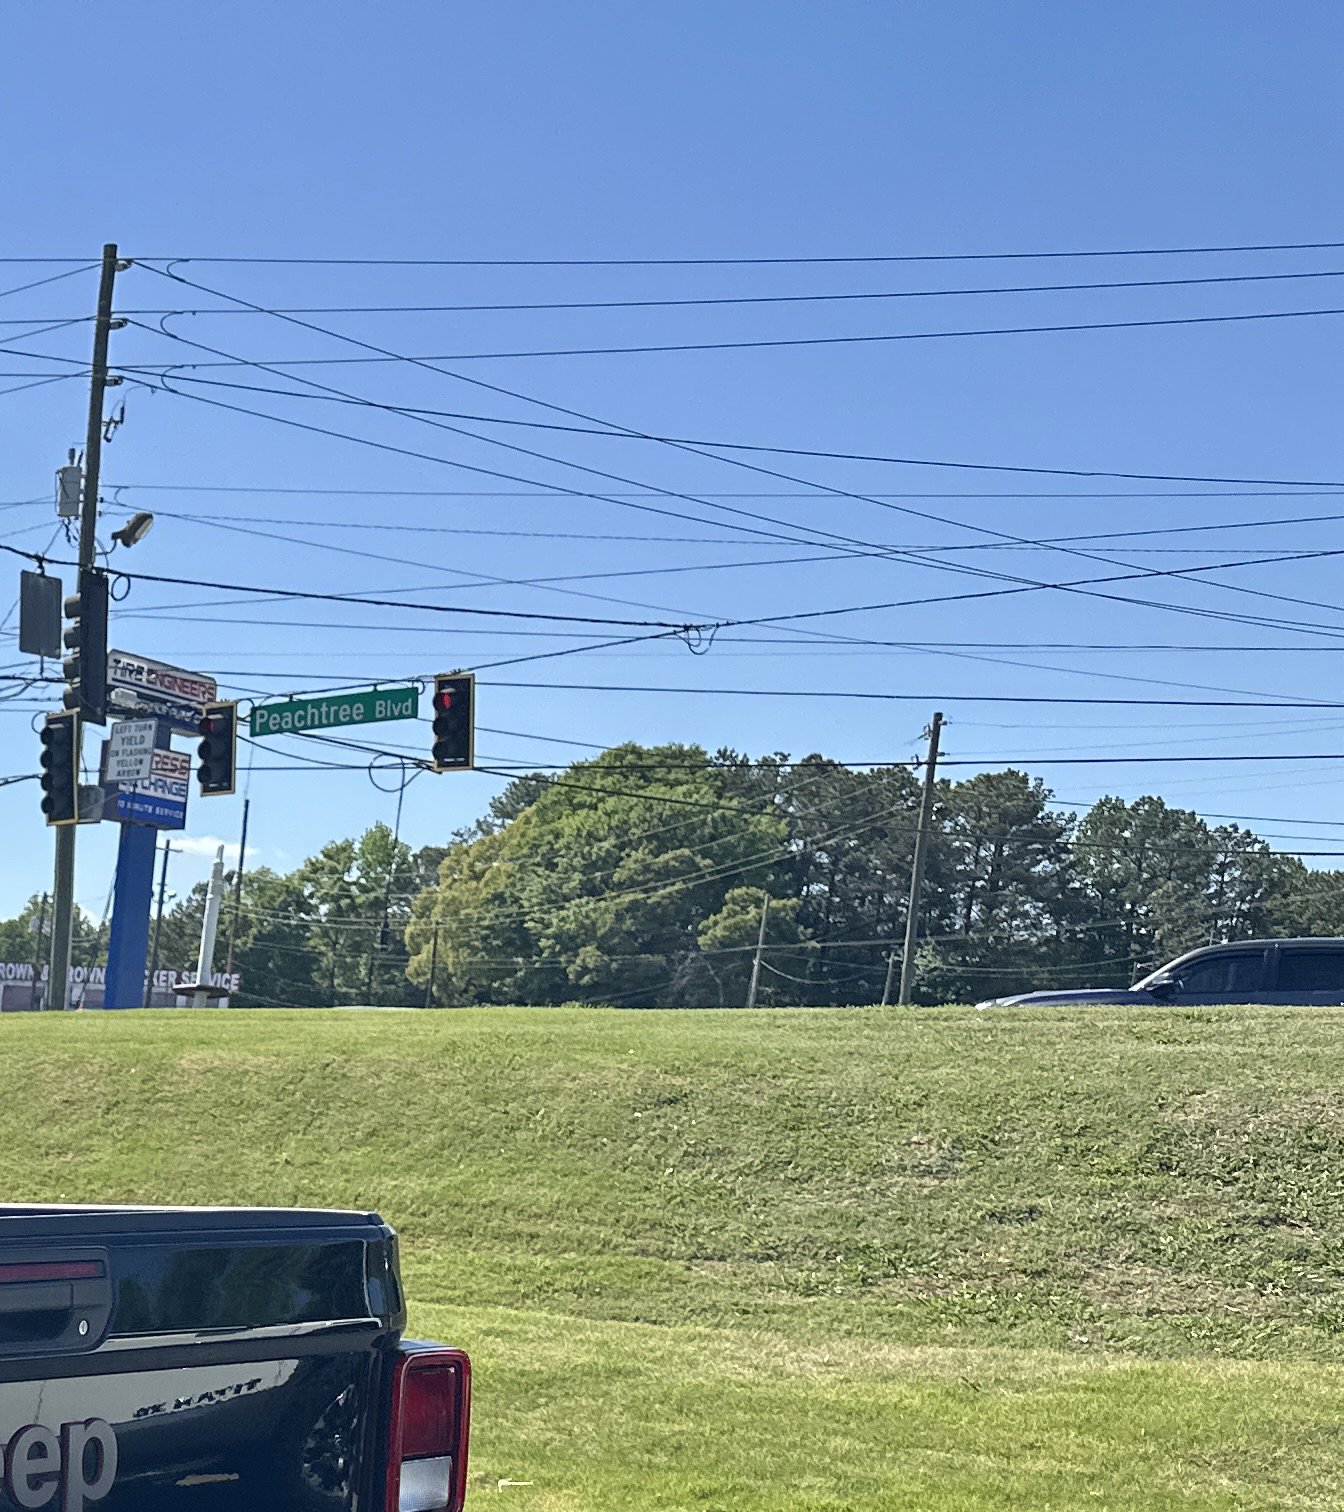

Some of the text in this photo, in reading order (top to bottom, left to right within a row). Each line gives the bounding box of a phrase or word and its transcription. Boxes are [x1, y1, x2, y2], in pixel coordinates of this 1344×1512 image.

[255, 695, 412, 732] Peachtree Blvd
[121, 735, 145, 746] YIELD
[153, 752, 189, 776] RESS
